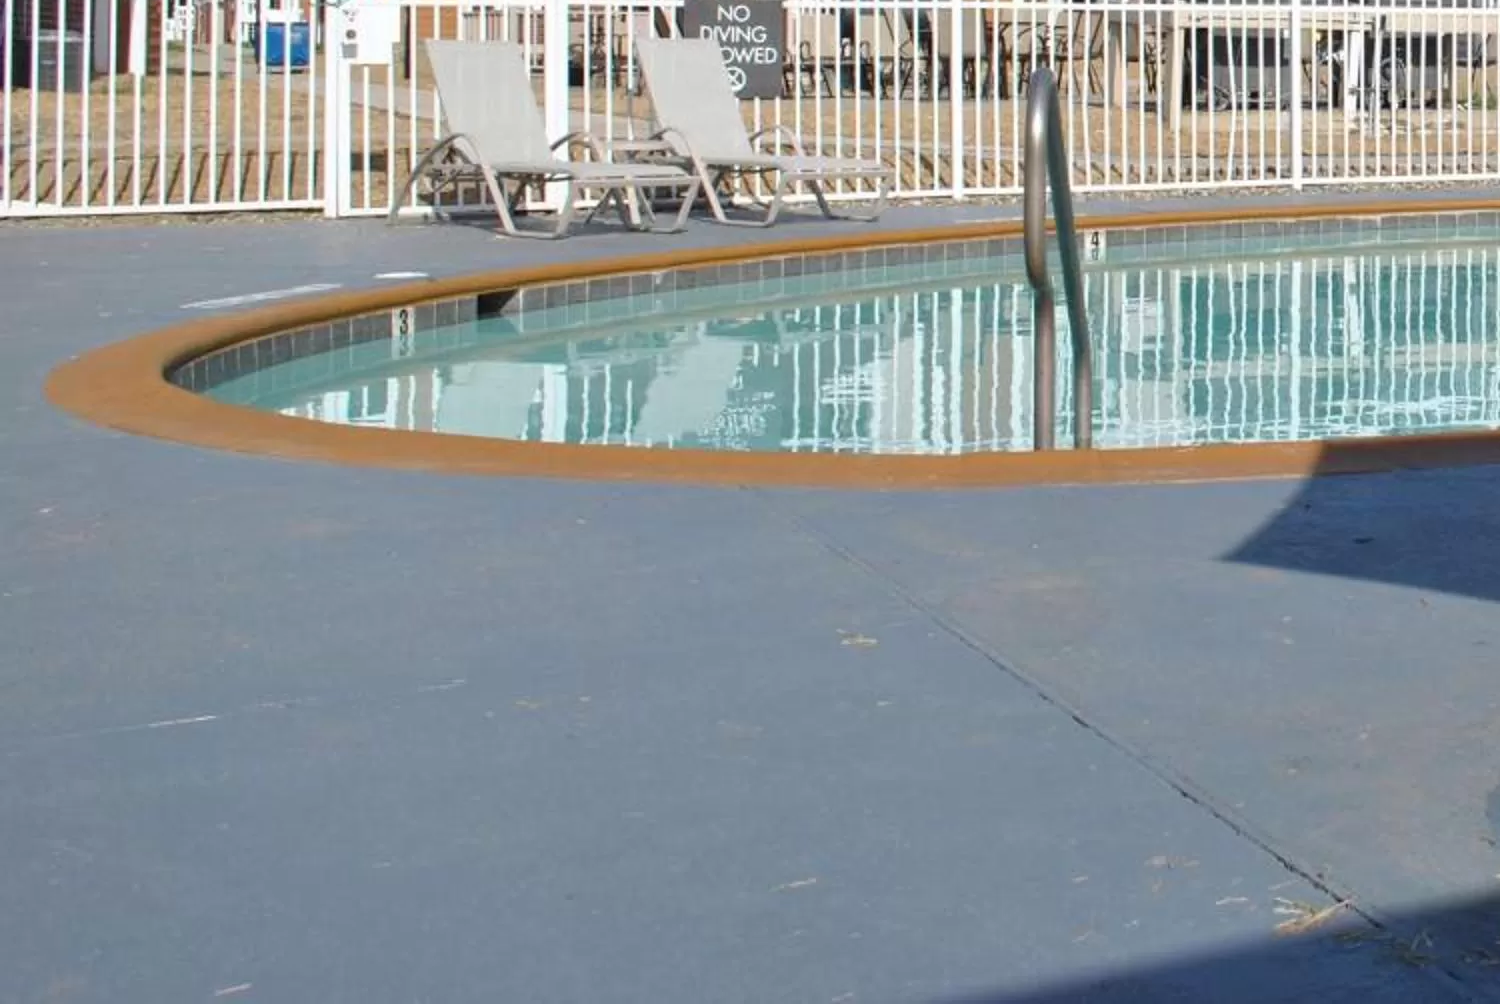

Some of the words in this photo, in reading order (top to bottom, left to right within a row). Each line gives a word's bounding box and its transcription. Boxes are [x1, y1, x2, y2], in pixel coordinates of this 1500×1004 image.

[717, 4, 751, 23] NO
[700, 25, 768, 43] DIVING
[720, 46, 777, 65] OWED
[1091, 231, 1100, 247] 4
[399, 308, 410, 335] 3
